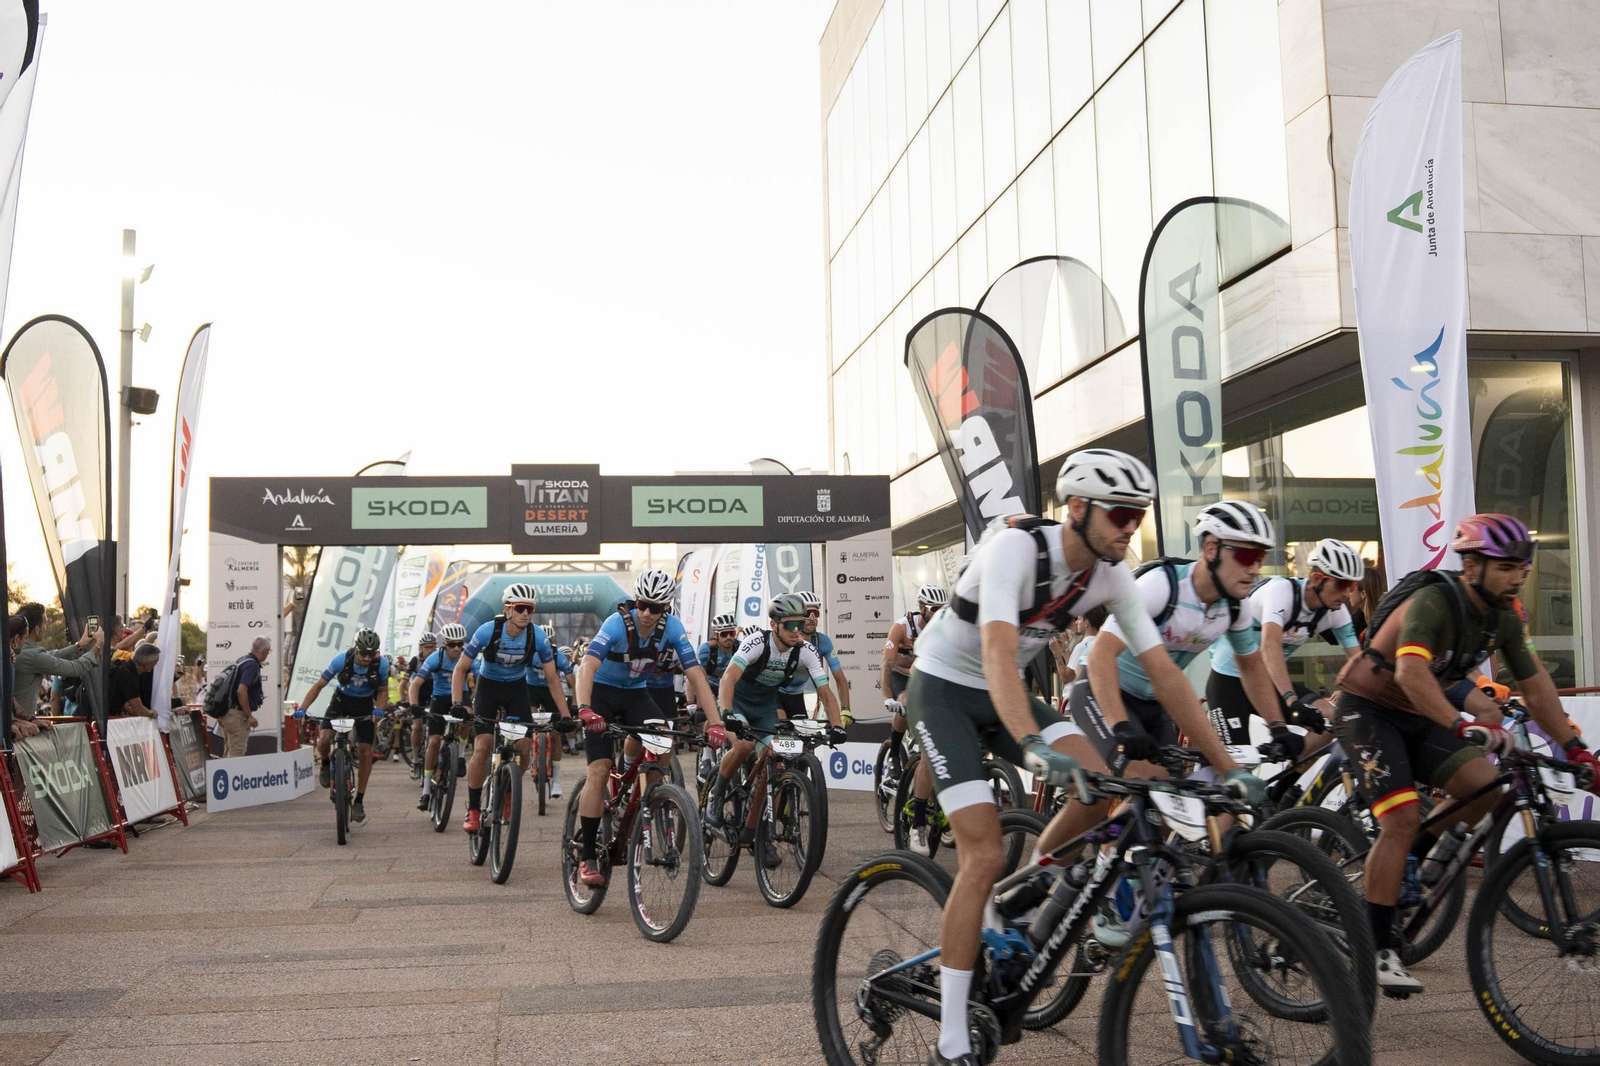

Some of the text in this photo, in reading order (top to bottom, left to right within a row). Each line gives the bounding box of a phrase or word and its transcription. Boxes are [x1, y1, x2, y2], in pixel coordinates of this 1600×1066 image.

[1425, 158, 1438, 257] Junta de Andalucía
[1168, 262, 1220, 556] KODA
[261, 487, 336, 506] Andalucía
[515, 479, 589, 504] TITAN
[525, 509, 589, 521] DESERT
[777, 514, 871, 523] DIPUTACIÓN DE ALMERÍA
[533, 523, 579, 534] ALMERÍA
[750, 544, 767, 592] Cleard
[316, 546, 366, 651] SKO
[532, 584, 594, 596] VERSAE
[915, 720, 951, 780] primaflor
[231, 769, 289, 792] Cleardent
[1481, 990, 1521, 1040] MAXXIS
